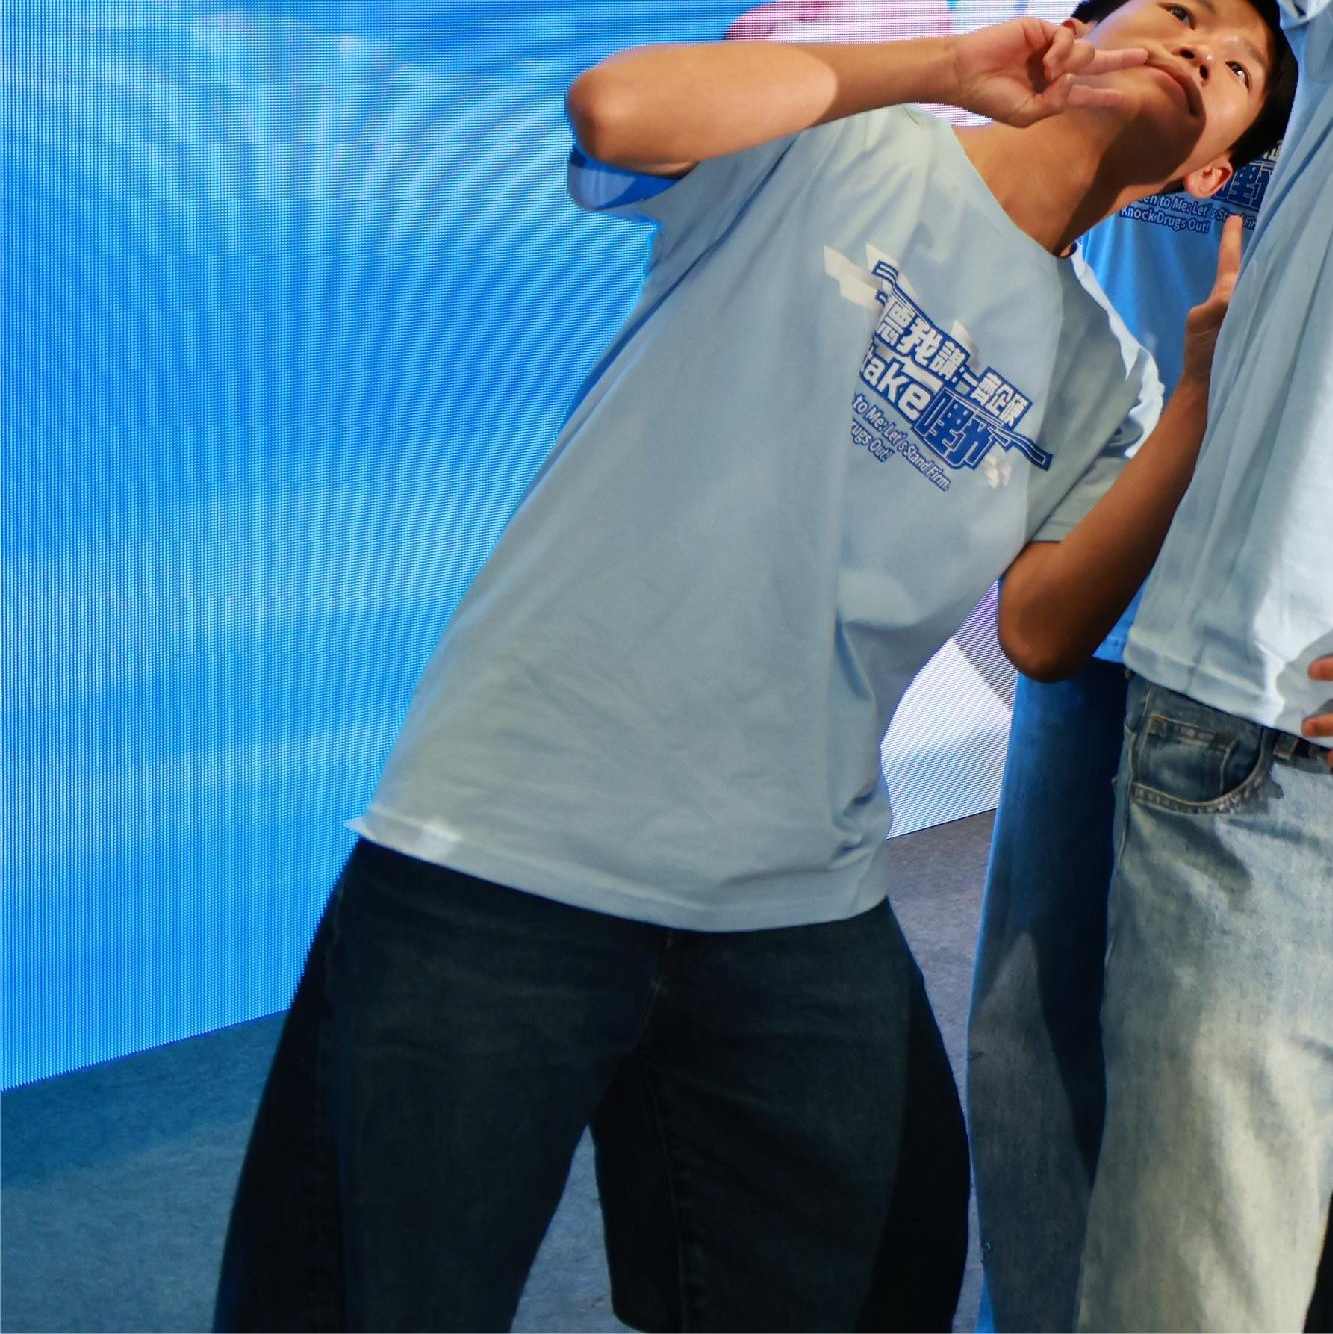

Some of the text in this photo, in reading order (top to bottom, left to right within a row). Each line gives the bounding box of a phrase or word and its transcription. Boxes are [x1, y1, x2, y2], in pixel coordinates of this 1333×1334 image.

[1120, 206, 1211, 234] Knock Drugs Out!
[852, 394, 868, 414] to
[864, 406, 889, 431] Me:
[903, 444, 933, 475] Stand
[868, 440, 894, 462] Out!
